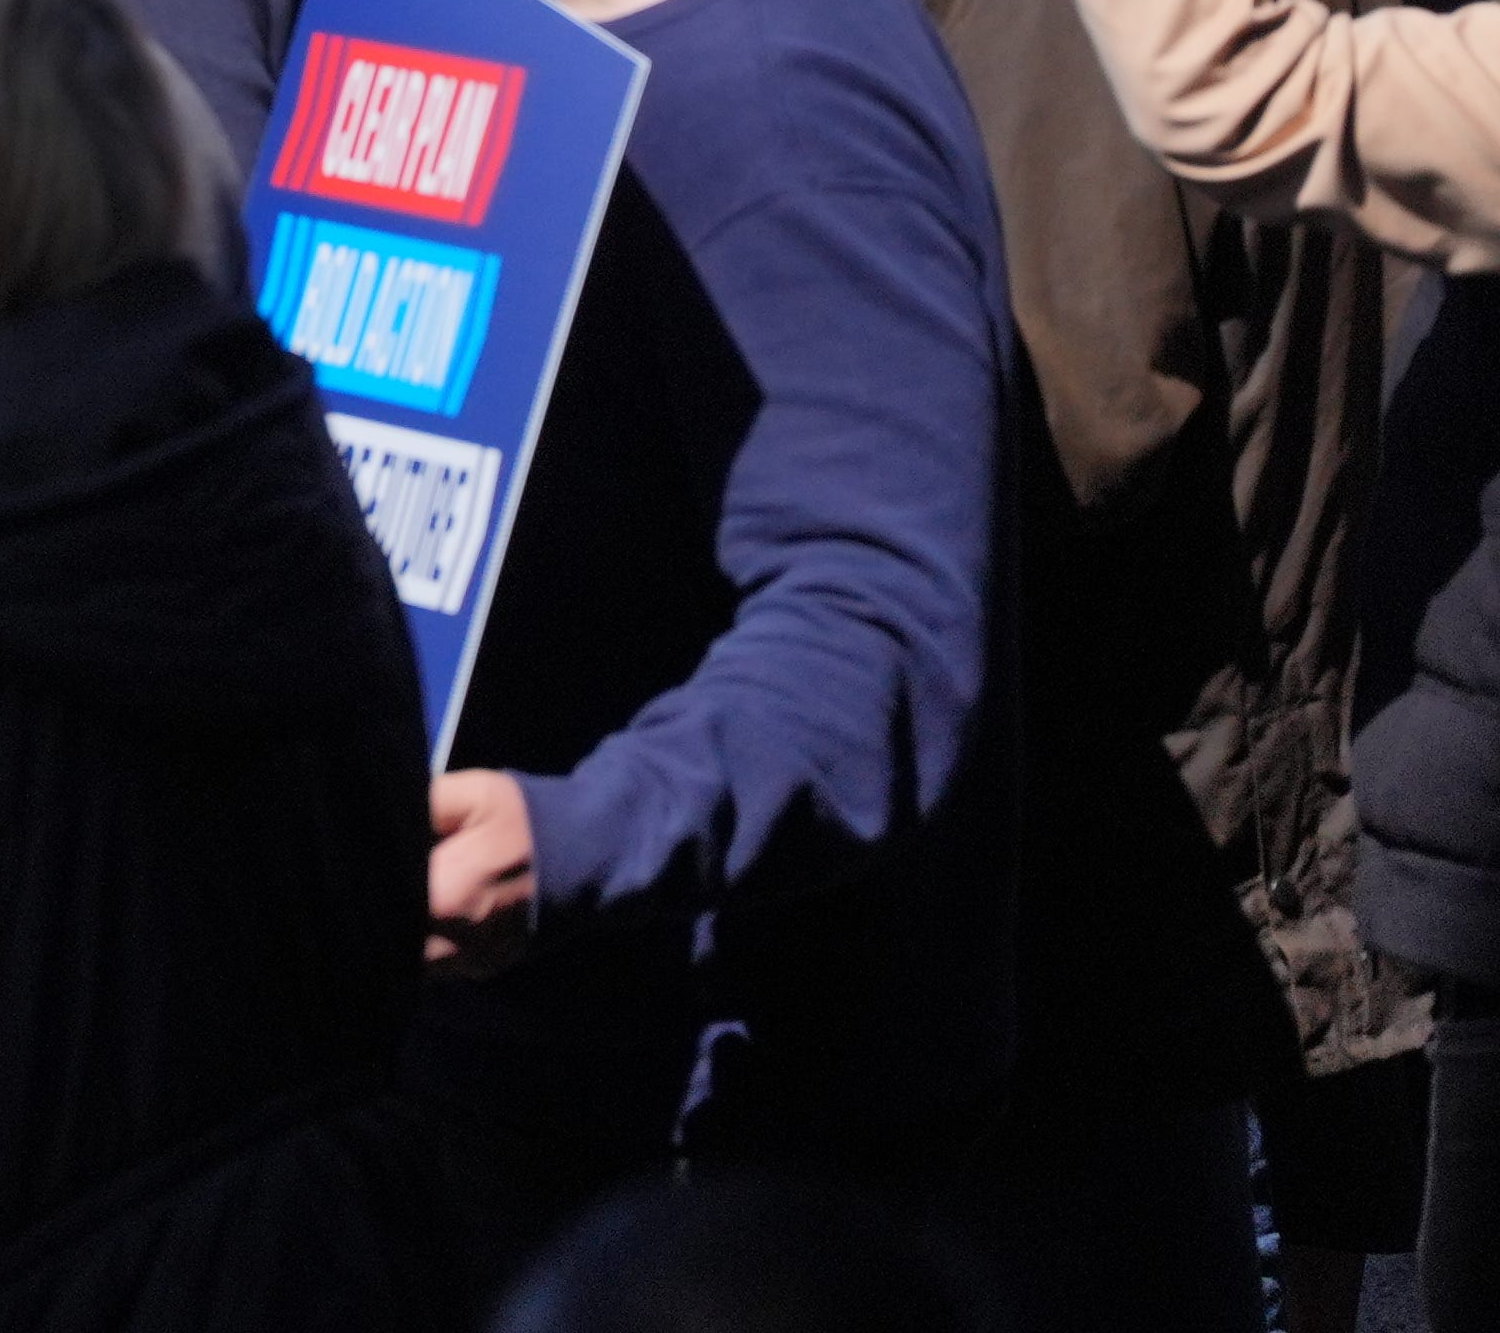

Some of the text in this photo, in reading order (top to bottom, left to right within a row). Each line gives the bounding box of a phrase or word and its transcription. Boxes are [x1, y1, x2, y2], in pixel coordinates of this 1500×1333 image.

[322, 59, 498, 201] CLEAR PLAN
[289, 243, 474, 388] BOLD ACTION
